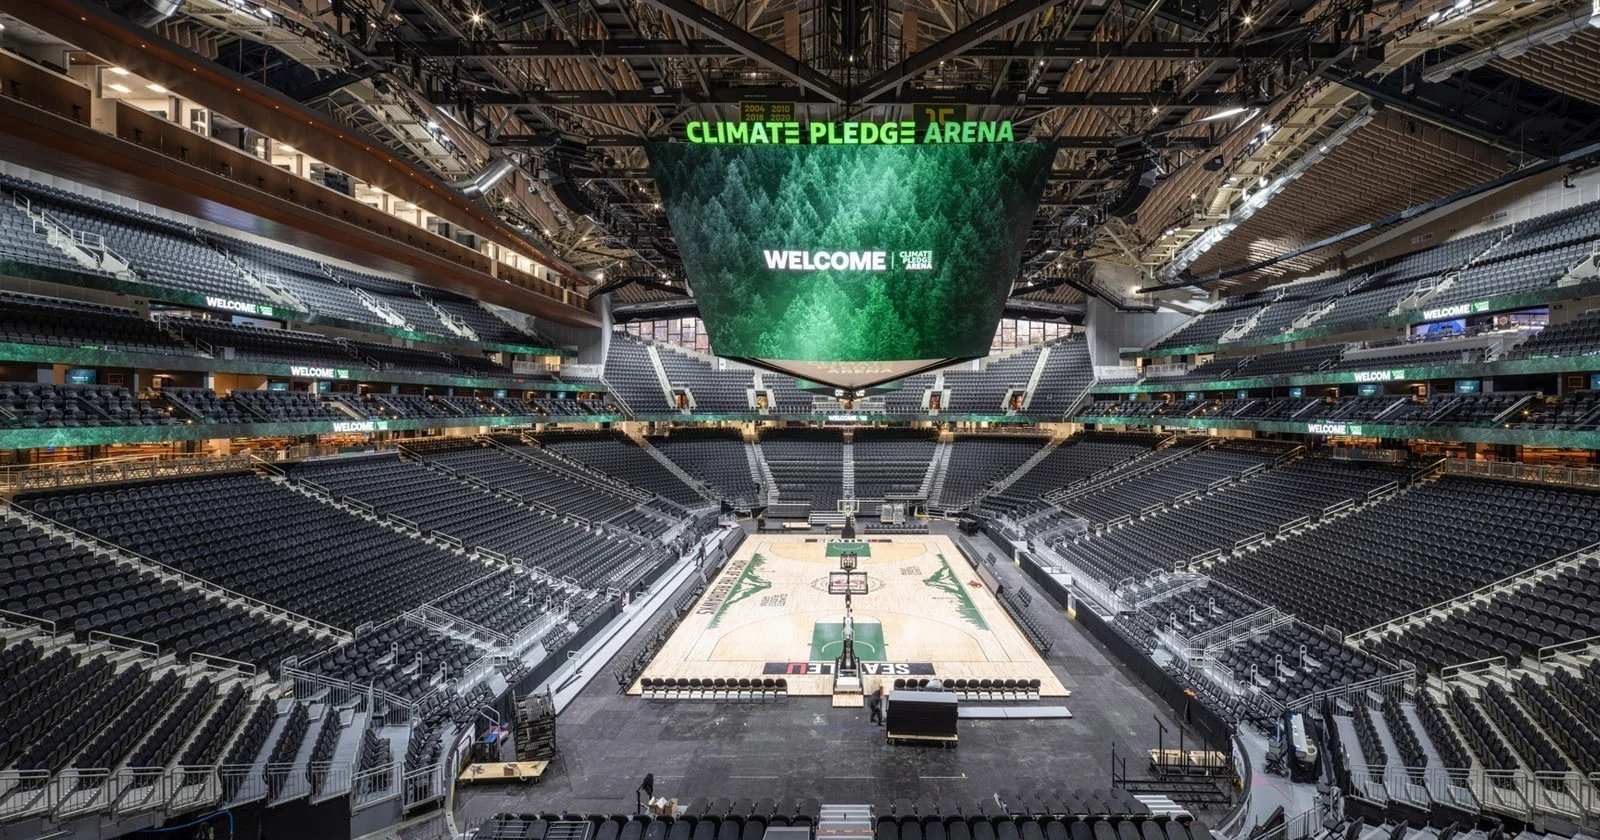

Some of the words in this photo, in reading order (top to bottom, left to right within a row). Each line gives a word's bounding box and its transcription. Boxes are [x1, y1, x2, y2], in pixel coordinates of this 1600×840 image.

[744, 104, 765, 113] 2004
[771, 105, 790, 113] 2010
[745, 113, 765, 121] 2018
[686, 121, 800, 144] CLIMATE
[810, 121, 915, 144] PLEDGE
[923, 120, 1015, 144] ARENA
[899, 250, 932, 258] CLIMATE
[763, 249, 887, 271] WELCOME
[906, 262, 933, 270] ARENA
[206, 296, 257, 314] WELCOME
[1423, 303, 1471, 320] WELCOME
[291, 366, 334, 378] WELCOME
[1354, 370, 1391, 382] WELCOM
[333, 421, 374, 432] WELCOME
[1308, 424, 1346, 434] WELCOME
